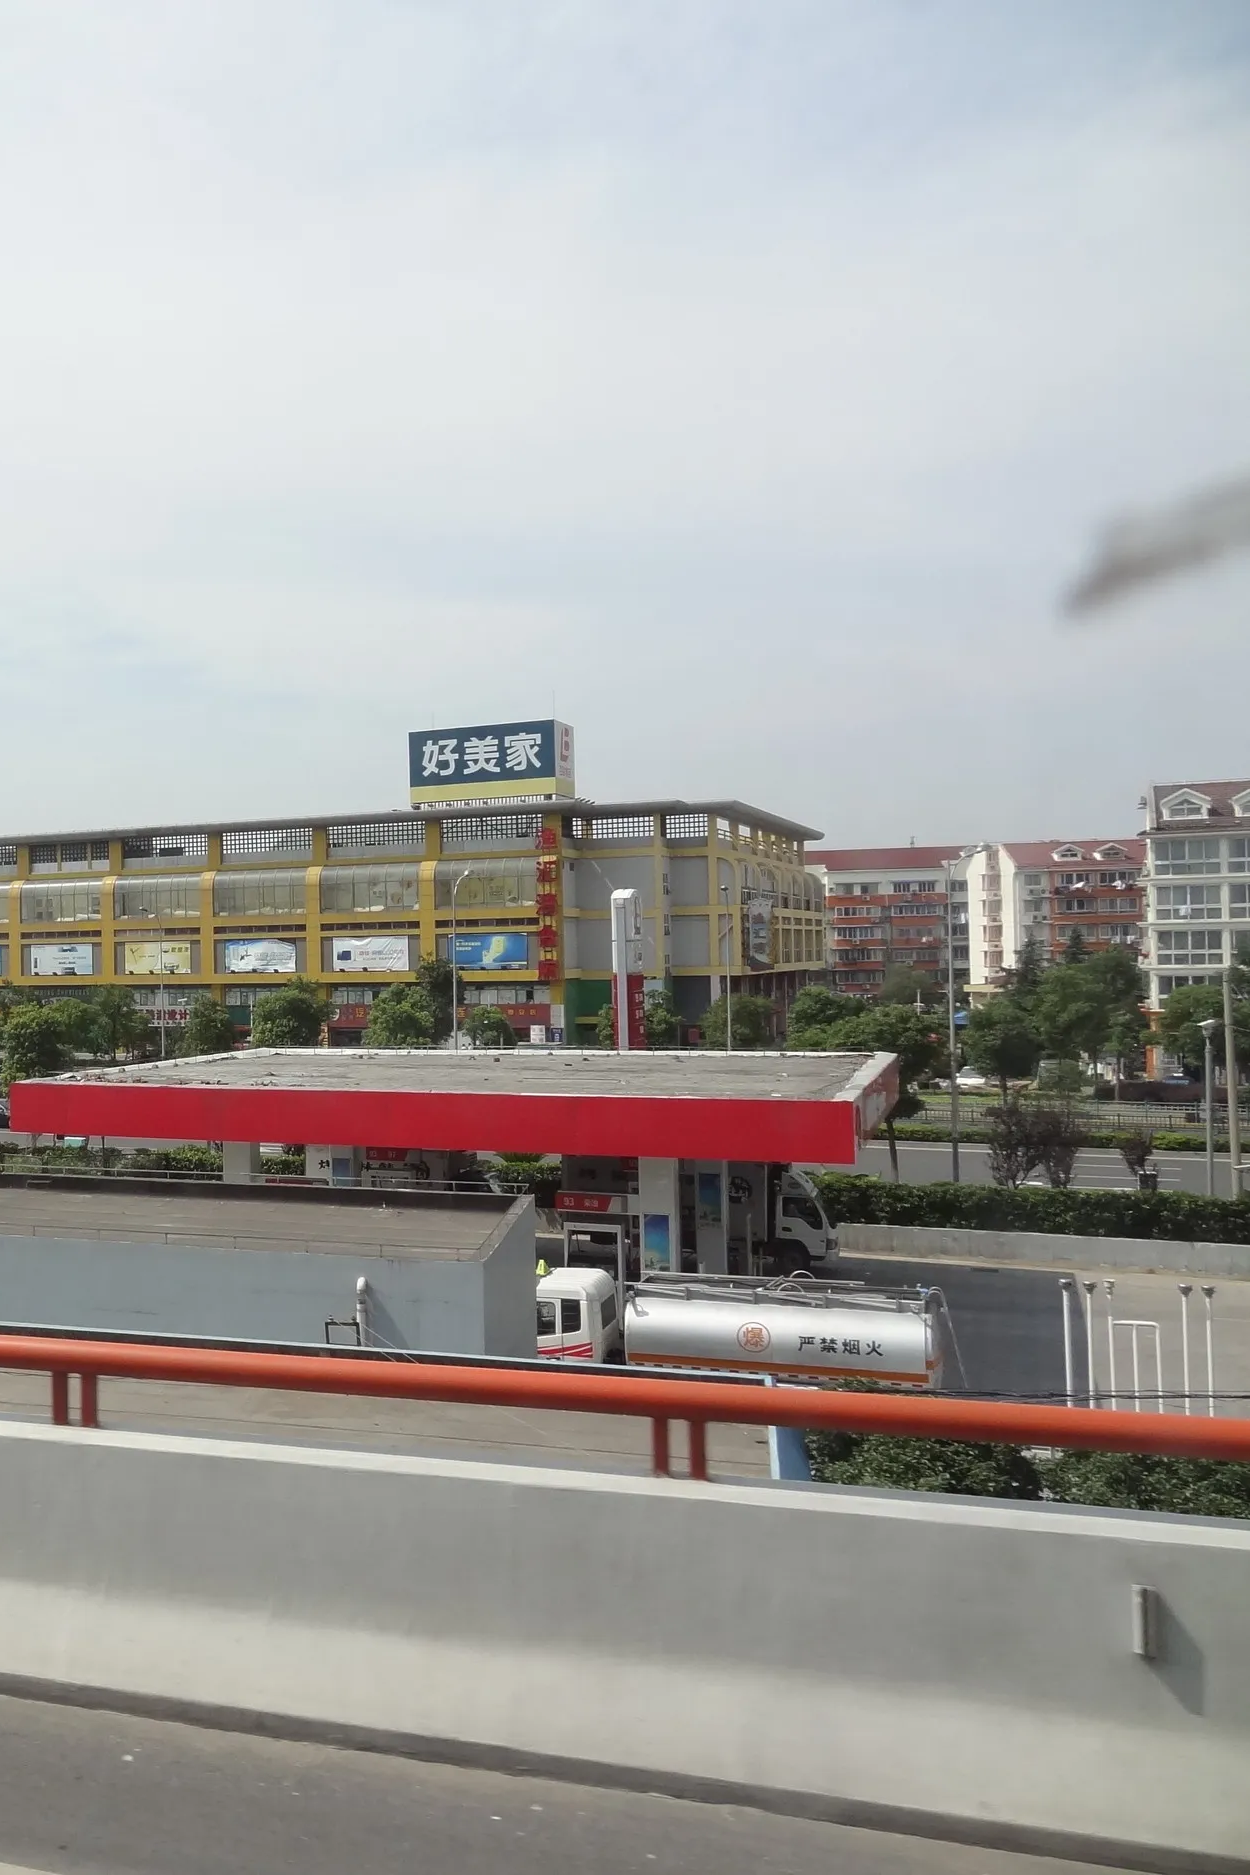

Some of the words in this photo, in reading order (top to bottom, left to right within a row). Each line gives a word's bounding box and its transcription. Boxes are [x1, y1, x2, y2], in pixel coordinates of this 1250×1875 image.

[422, 732, 542, 777] 好美家
[563, 1197, 574, 1206] 93
[743, 1327, 765, 1348] 爆
[798, 1335, 883, 1356] 严禁烟火
